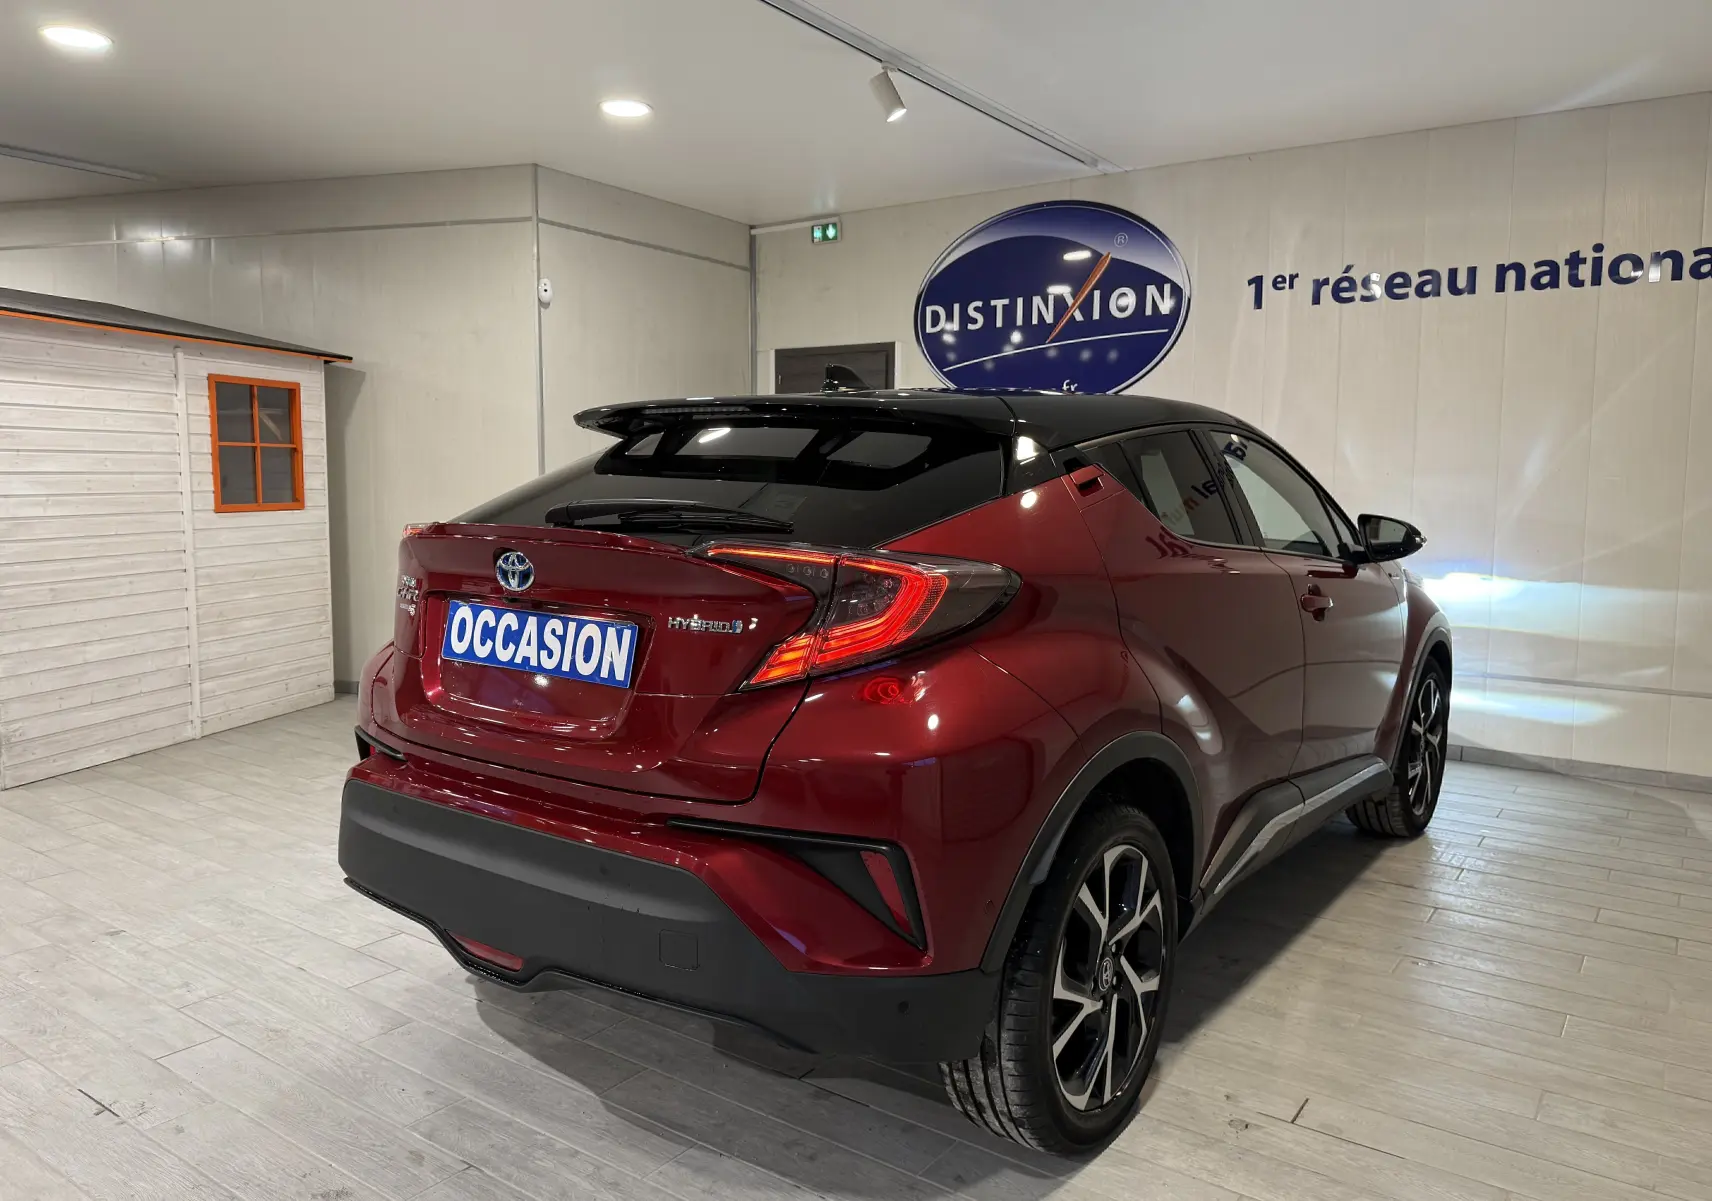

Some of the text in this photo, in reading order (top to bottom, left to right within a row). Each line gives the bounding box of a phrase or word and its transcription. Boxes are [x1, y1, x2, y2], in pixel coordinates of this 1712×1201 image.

[925, 282, 1173, 334] DISTINXION
[1247, 272, 1300, 310] 1er
[1311, 264, 1478, 306] réseau
[450, 606, 632, 681] OCCASION
[667, 616, 731, 633] HYBRID
